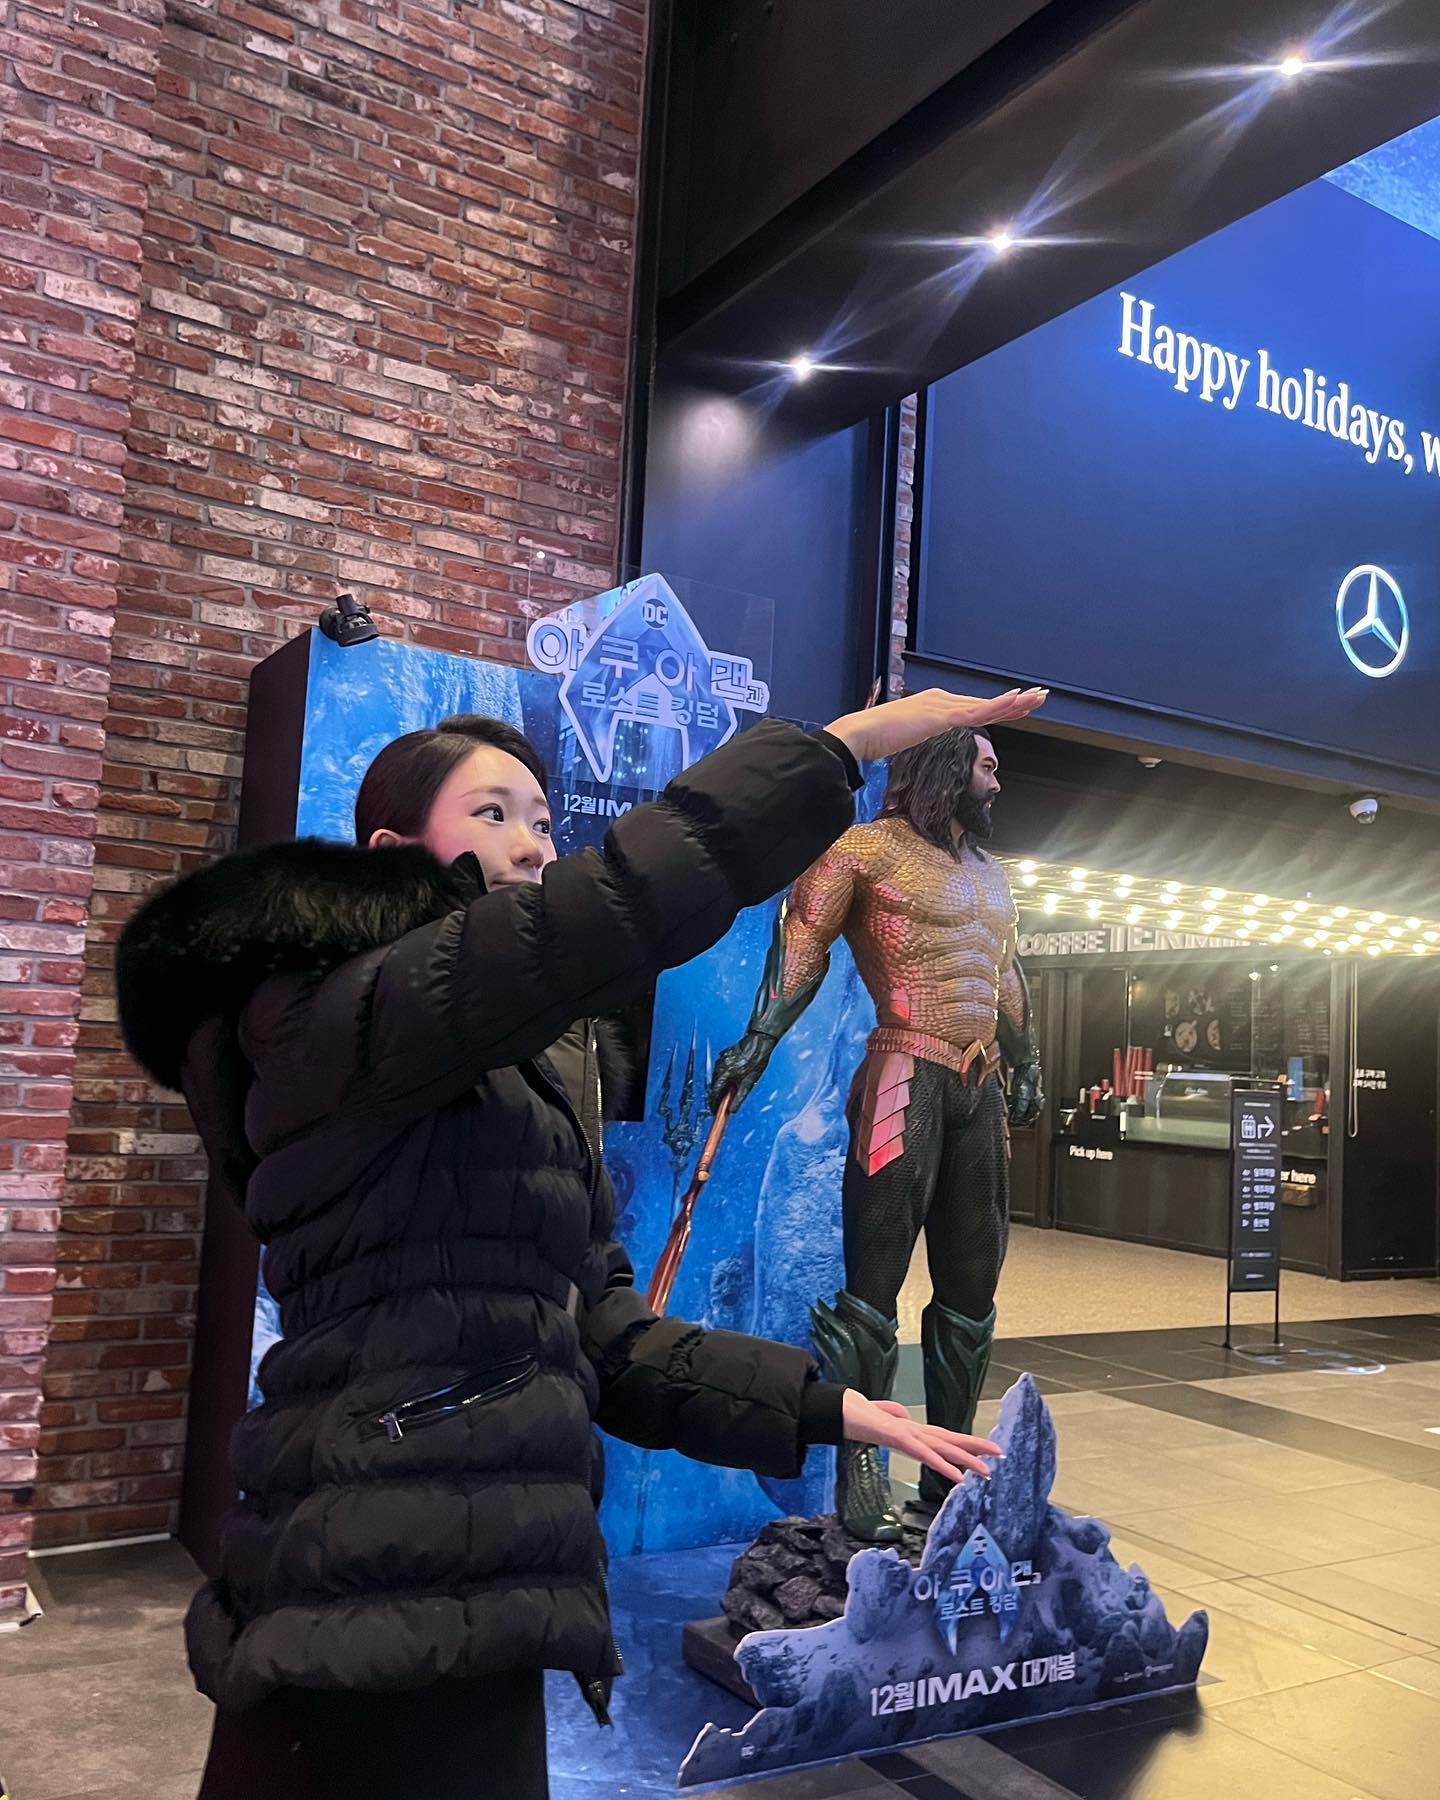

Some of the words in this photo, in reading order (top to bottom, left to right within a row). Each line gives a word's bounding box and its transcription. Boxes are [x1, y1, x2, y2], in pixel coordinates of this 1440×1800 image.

[1118, 291, 1250, 410] Happy
[1256, 349, 1414, 474] holidays,
[644, 600, 669, 628] DC
[581, 680, 660, 718] 로스트
[671, 697, 719, 729] 킹덤
[1017, 930, 1105, 957] COFFEE
[1069, 1145, 1085, 1157] Pick
[1085, 1149, 1096, 1160] up
[1096, 1147, 1113, 1161] here
[1291, 1169, 1317, 1185] here
[916, 1662, 1017, 1708] IMAX
[1021, 1651, 1076, 1688] 대개봉
